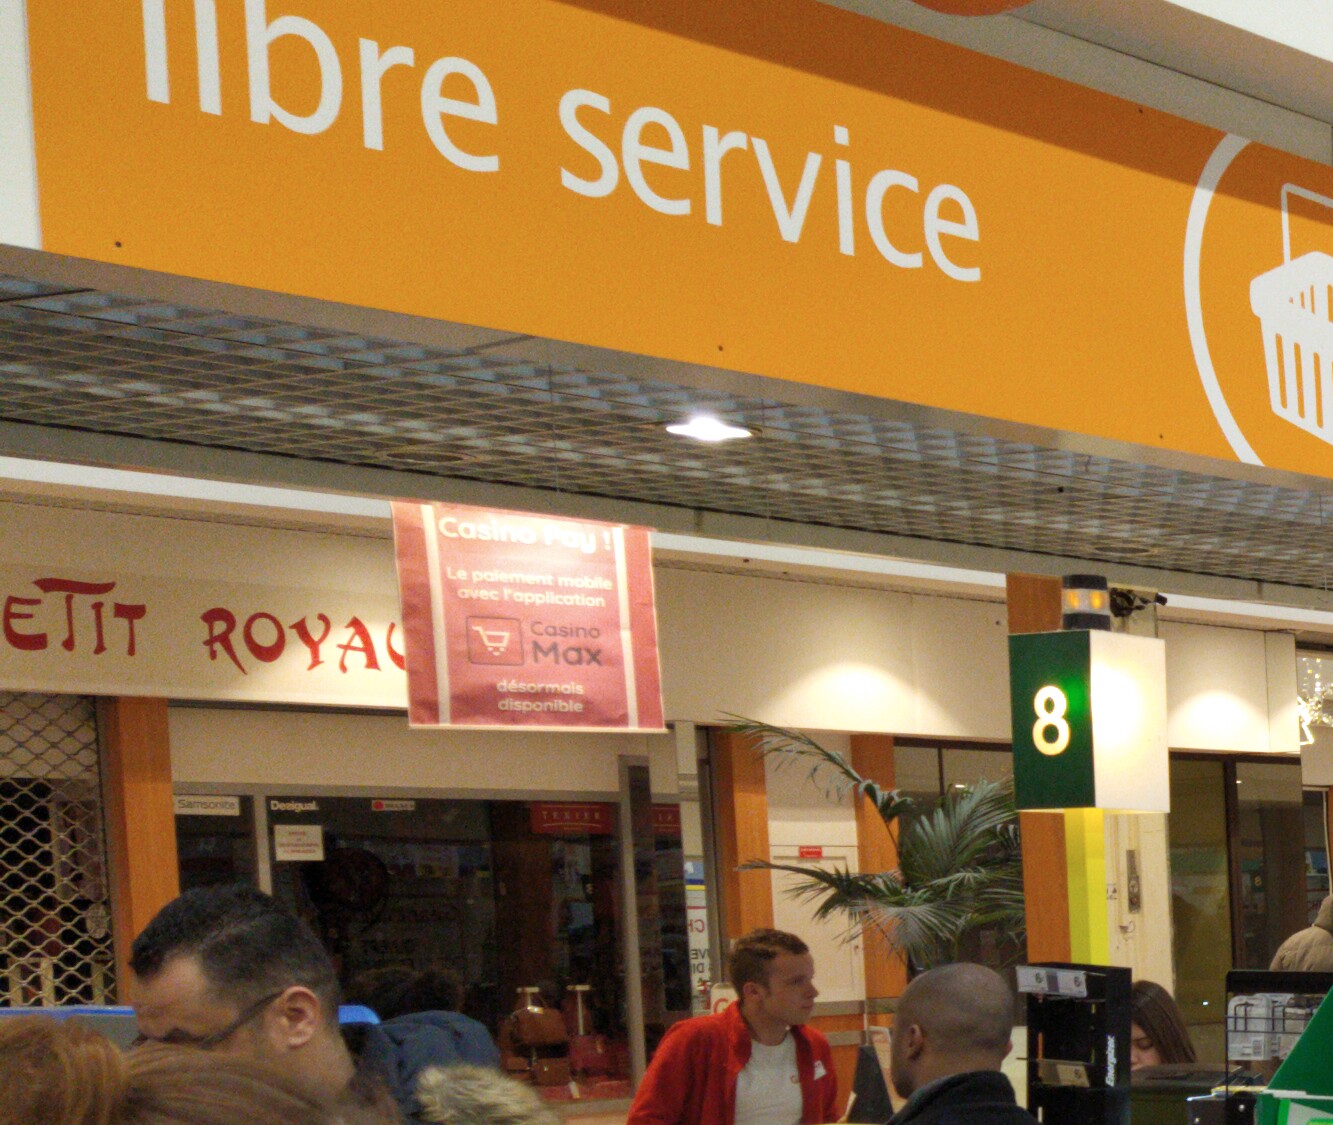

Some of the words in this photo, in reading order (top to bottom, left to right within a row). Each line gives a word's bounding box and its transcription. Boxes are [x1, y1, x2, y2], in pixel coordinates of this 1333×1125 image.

[141, 0, 500, 173] libre
[559, 88, 981, 283] service
[439, 516, 536, 545] Casino
[446, 567, 467, 581] Le
[473, 568, 554, 589] paiement
[558, 576, 613, 590] mobile
[458, 588, 499, 601] avec
[504, 588, 605, 608] l'application
[530, 621, 601, 639] Casino
[532, 641, 603, 666] Max
[497, 679, 584, 695] désormais
[498, 699, 583, 714] disponible
[1031, 684, 1070, 757] 8
